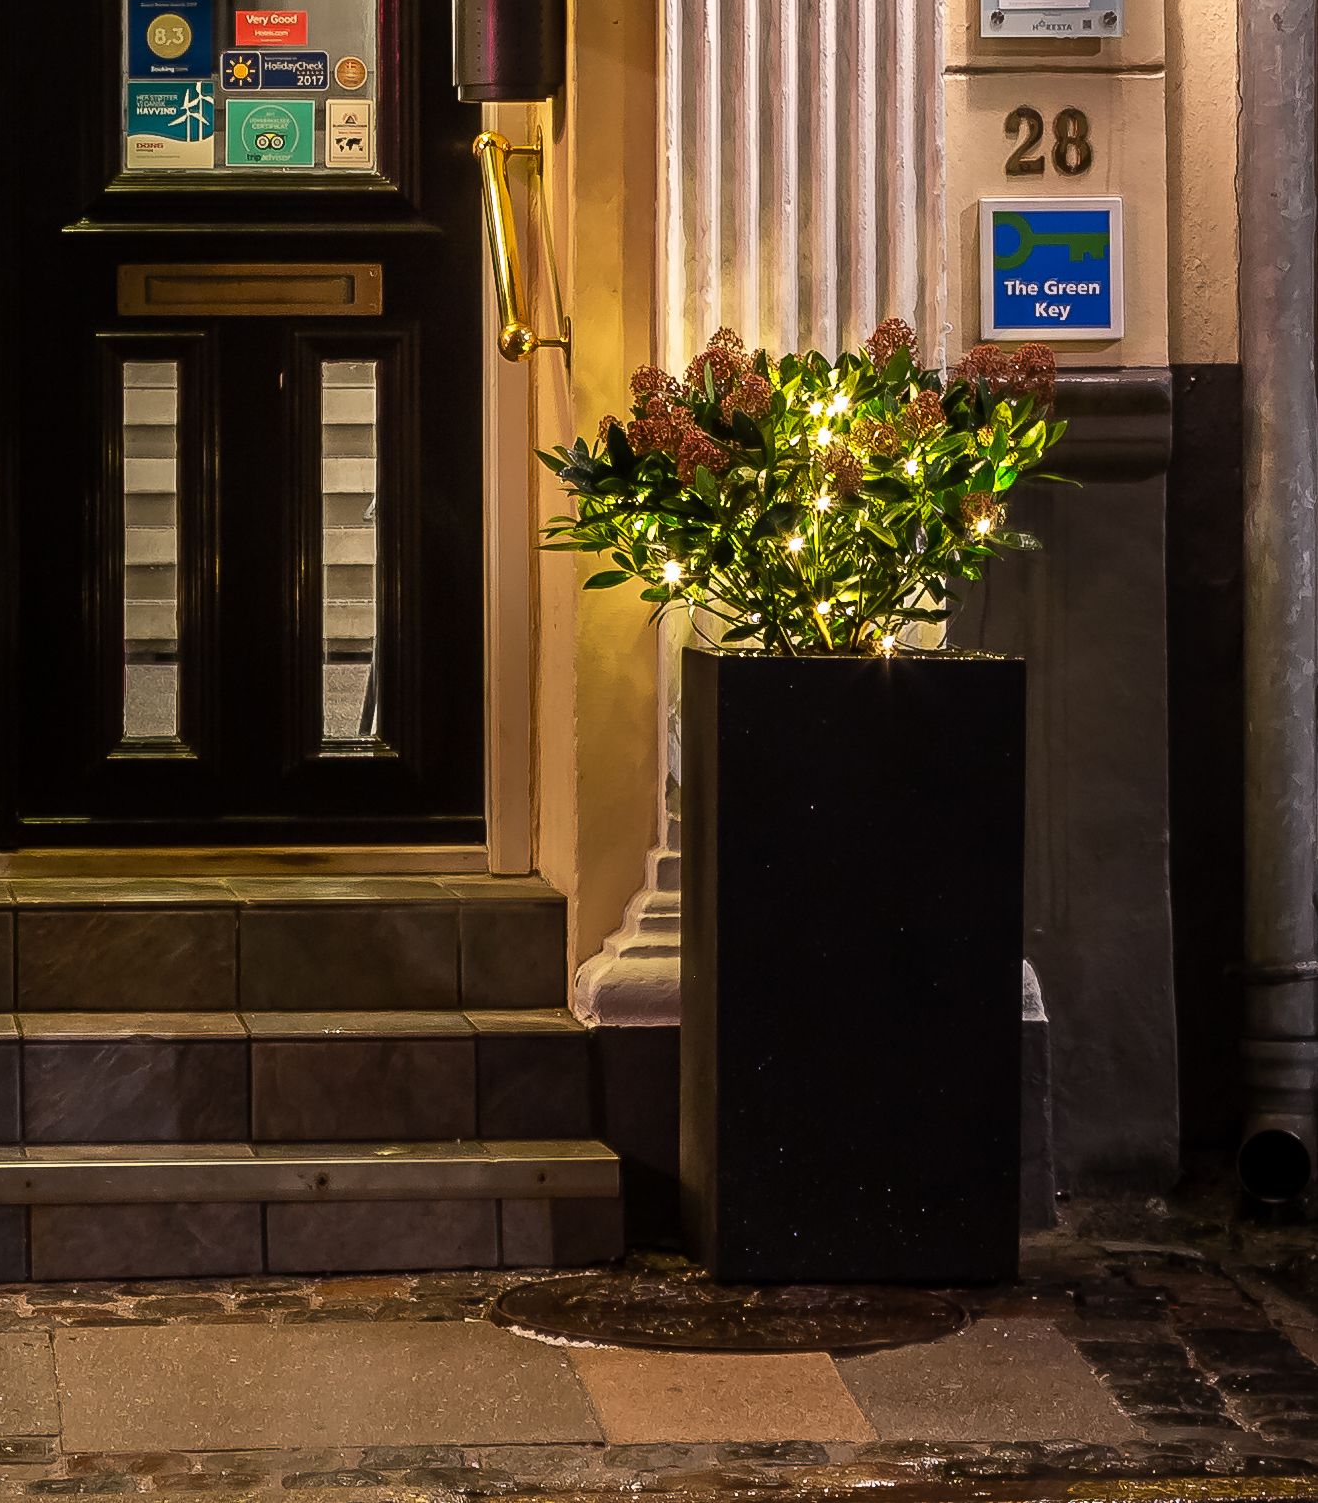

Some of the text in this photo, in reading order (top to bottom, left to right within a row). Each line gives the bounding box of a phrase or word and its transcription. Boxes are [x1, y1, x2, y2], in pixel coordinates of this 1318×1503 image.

[246, 14, 297, 26] Very Good
[154, 27, 184, 46] 8,3
[150, 65, 189, 73] Booking
[264, 61, 324, 73] HolidayCheck
[297, 76, 324, 86] 2017
[136, 107, 176, 115] HAVVIND
[1004, 106, 1092, 176] 28
[1004, 280, 1100, 295] The Green
[1035, 302, 1071, 320] Key
